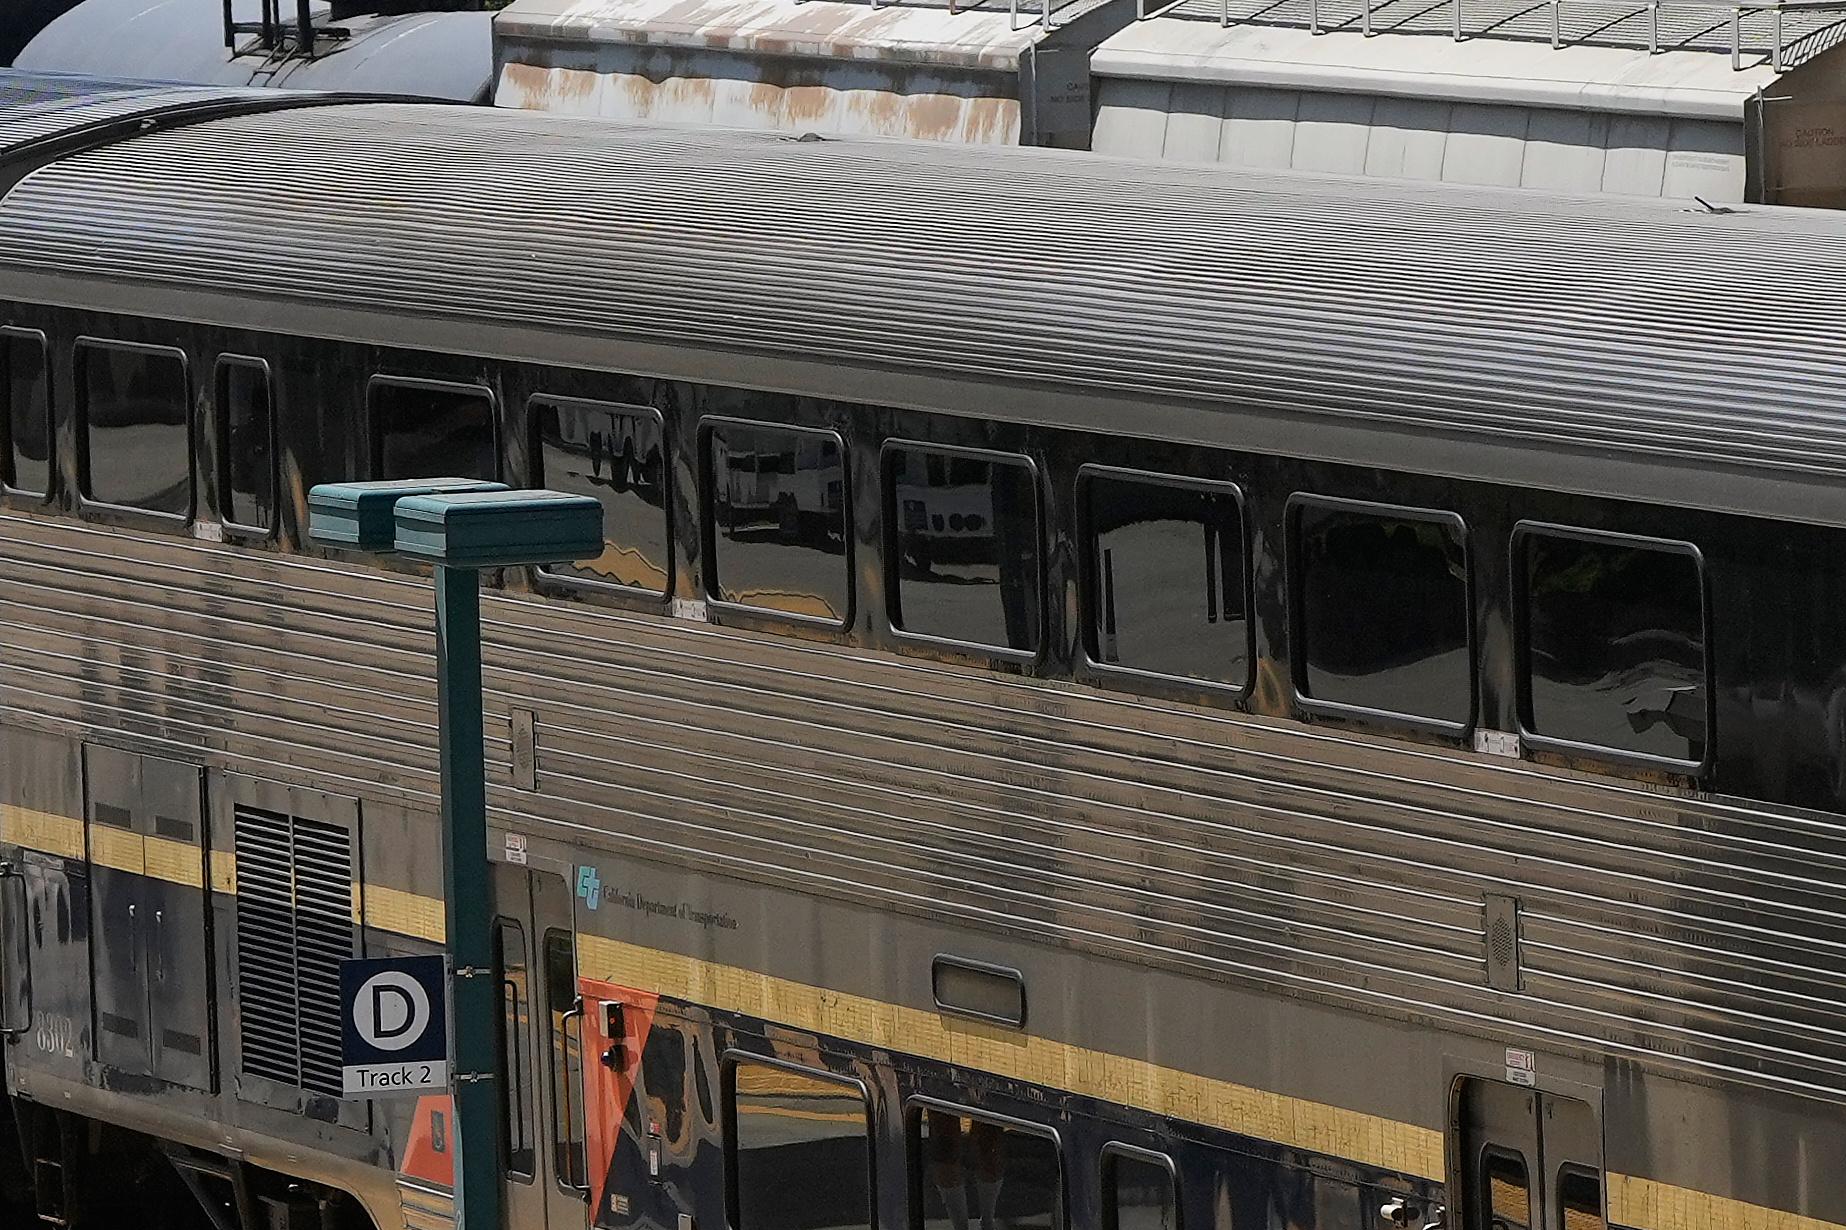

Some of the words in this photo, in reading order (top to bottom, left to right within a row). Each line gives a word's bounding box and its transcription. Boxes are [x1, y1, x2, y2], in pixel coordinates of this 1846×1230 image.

[36, 1010, 73, 1058] 8302
[372, 984, 416, 1038] D
[356, 1066, 413, 1087] Track
[420, 1065, 431, 1084] 2
